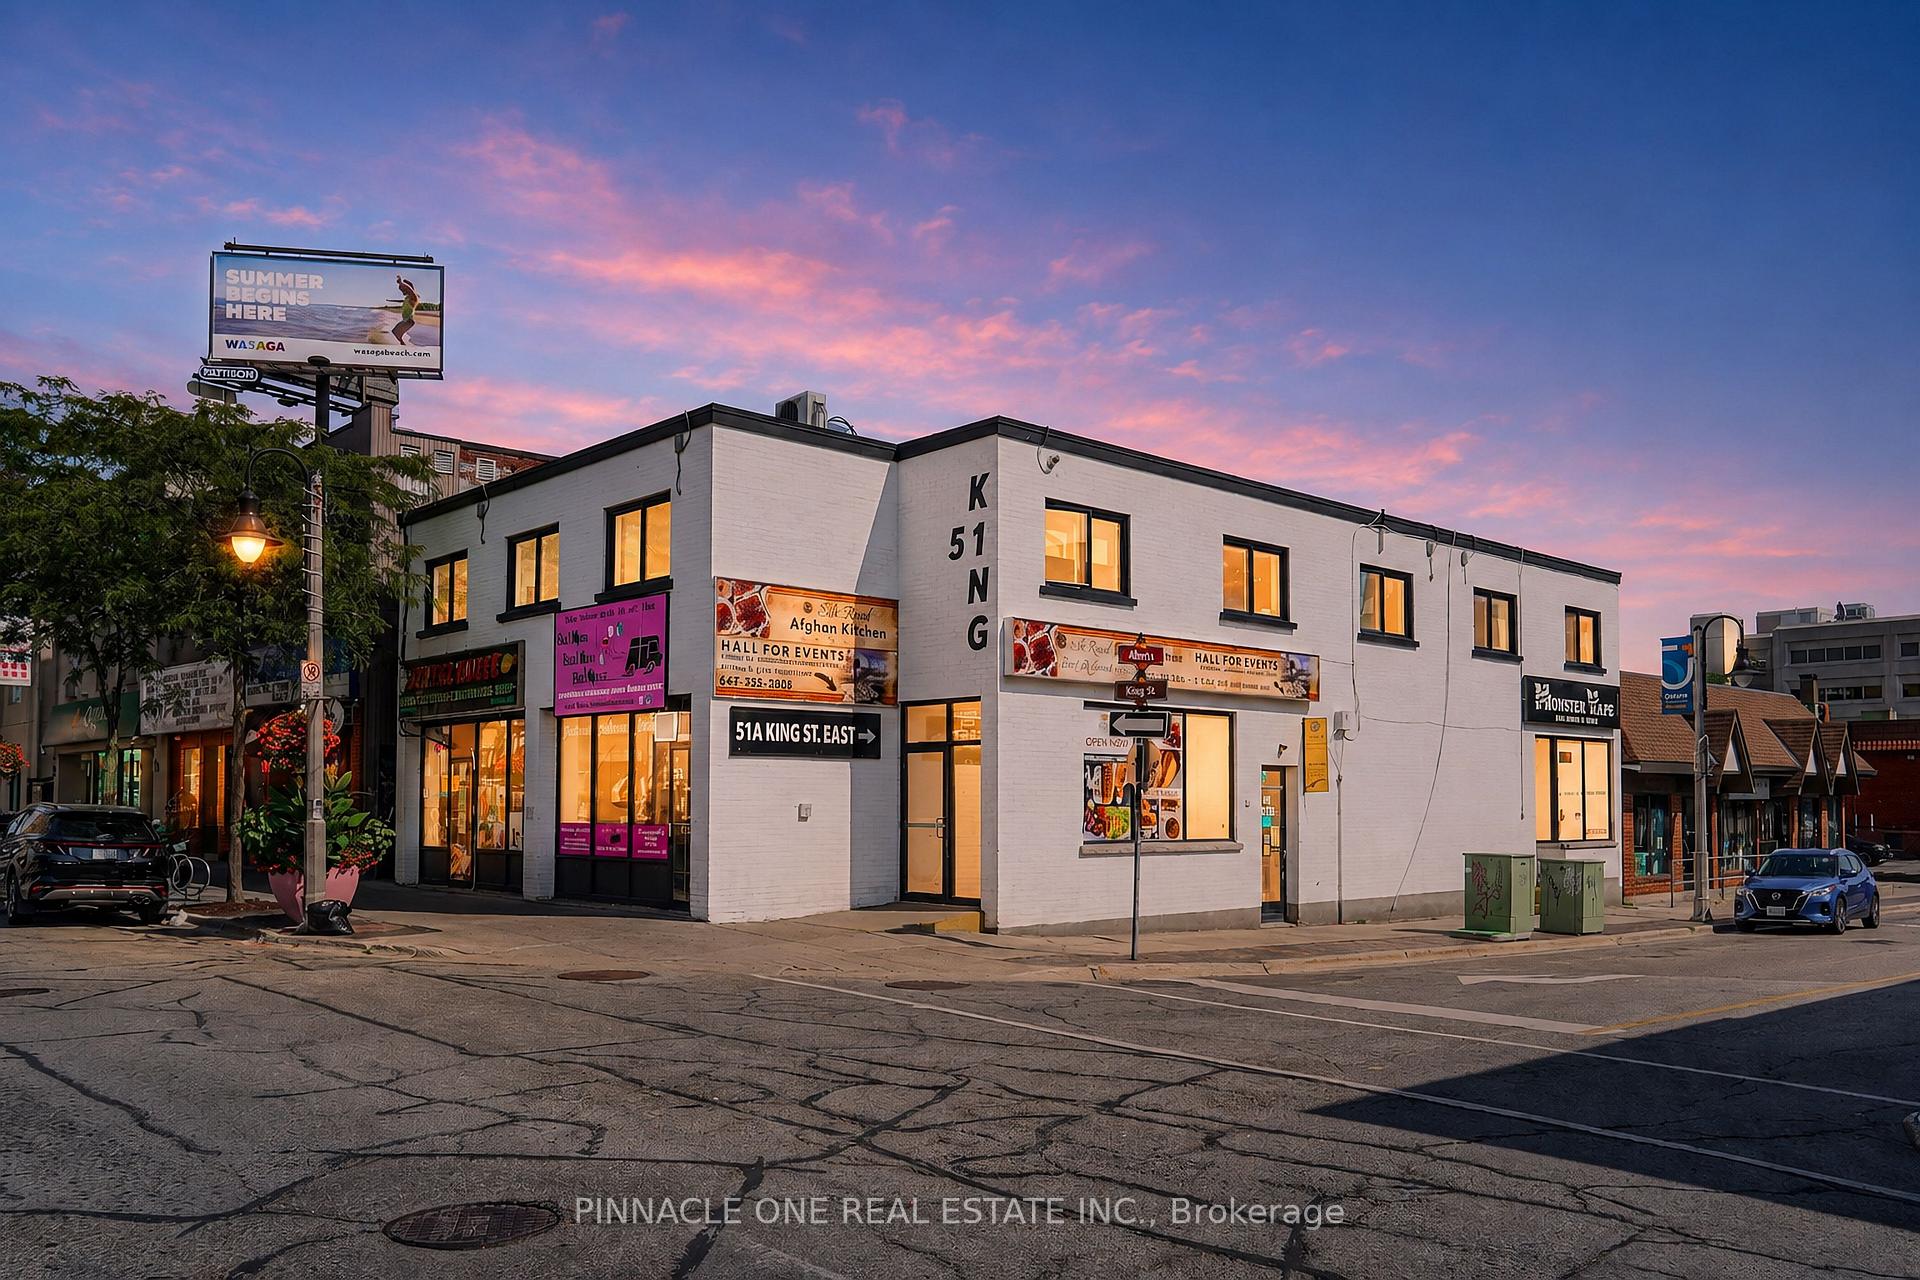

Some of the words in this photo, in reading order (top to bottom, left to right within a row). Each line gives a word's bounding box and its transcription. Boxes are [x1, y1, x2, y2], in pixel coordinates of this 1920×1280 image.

[225, 269, 323, 289] SUMMER
[225, 286, 310, 306] BEGINS
[225, 303, 287, 322] HERE
[225, 339, 286, 352] WASAGA
[790, 617, 837, 635] Afghan
[842, 623, 887, 639] Kitchen
[721, 640, 758, 654] HALL
[763, 644, 790, 657] FOR
[795, 649, 844, 661] EVENTS
[1195, 653, 1220, 665] HALL
[1223, 655, 1242, 667] FOR
[1245, 658, 1278, 671] EVENTS
[735, 721, 763, 741] 51A
[766, 722, 800, 742] KING
[803, 724, 821, 743] ST.
[824, 725, 856, 744] EAST
[1085, 737, 1108, 748] OPEN
